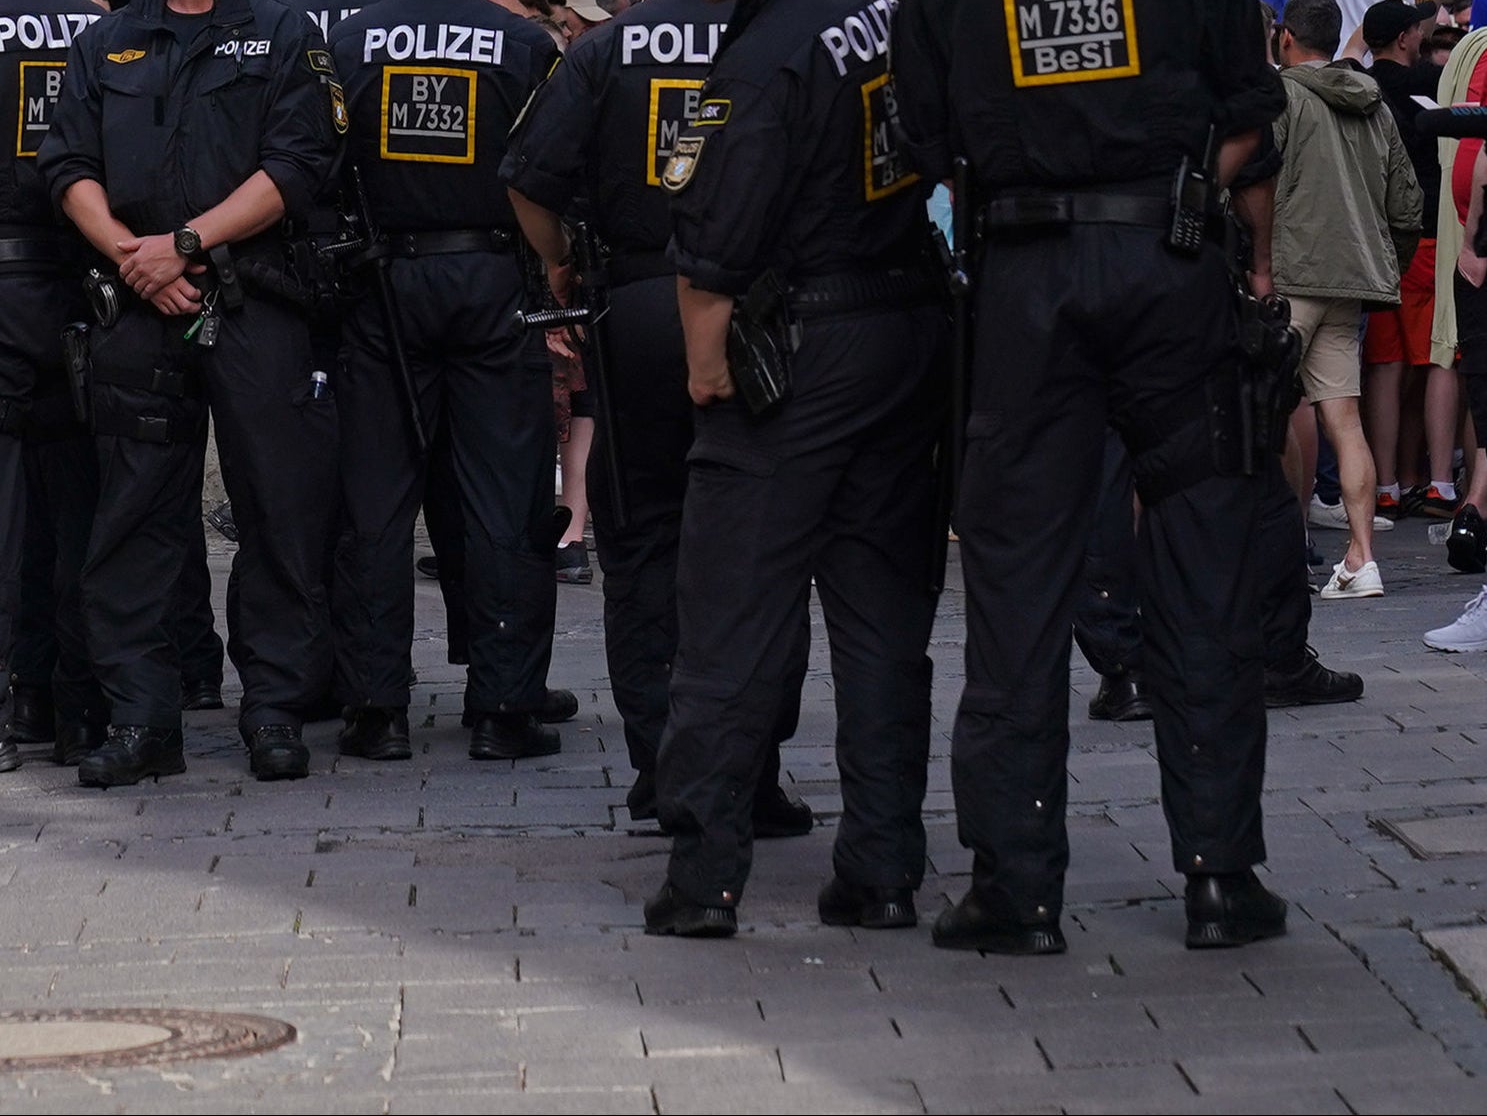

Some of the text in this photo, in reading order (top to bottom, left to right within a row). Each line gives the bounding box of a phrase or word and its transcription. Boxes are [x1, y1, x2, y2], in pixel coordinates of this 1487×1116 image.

[1019, 4, 1043, 39] M
[364, 23, 504, 65] POLIZEI
[622, 23, 728, 65] POLI
[1034, 40, 1113, 74] BeSi
[412, 76, 448, 102] BY
[392, 102, 464, 131] M 7332
